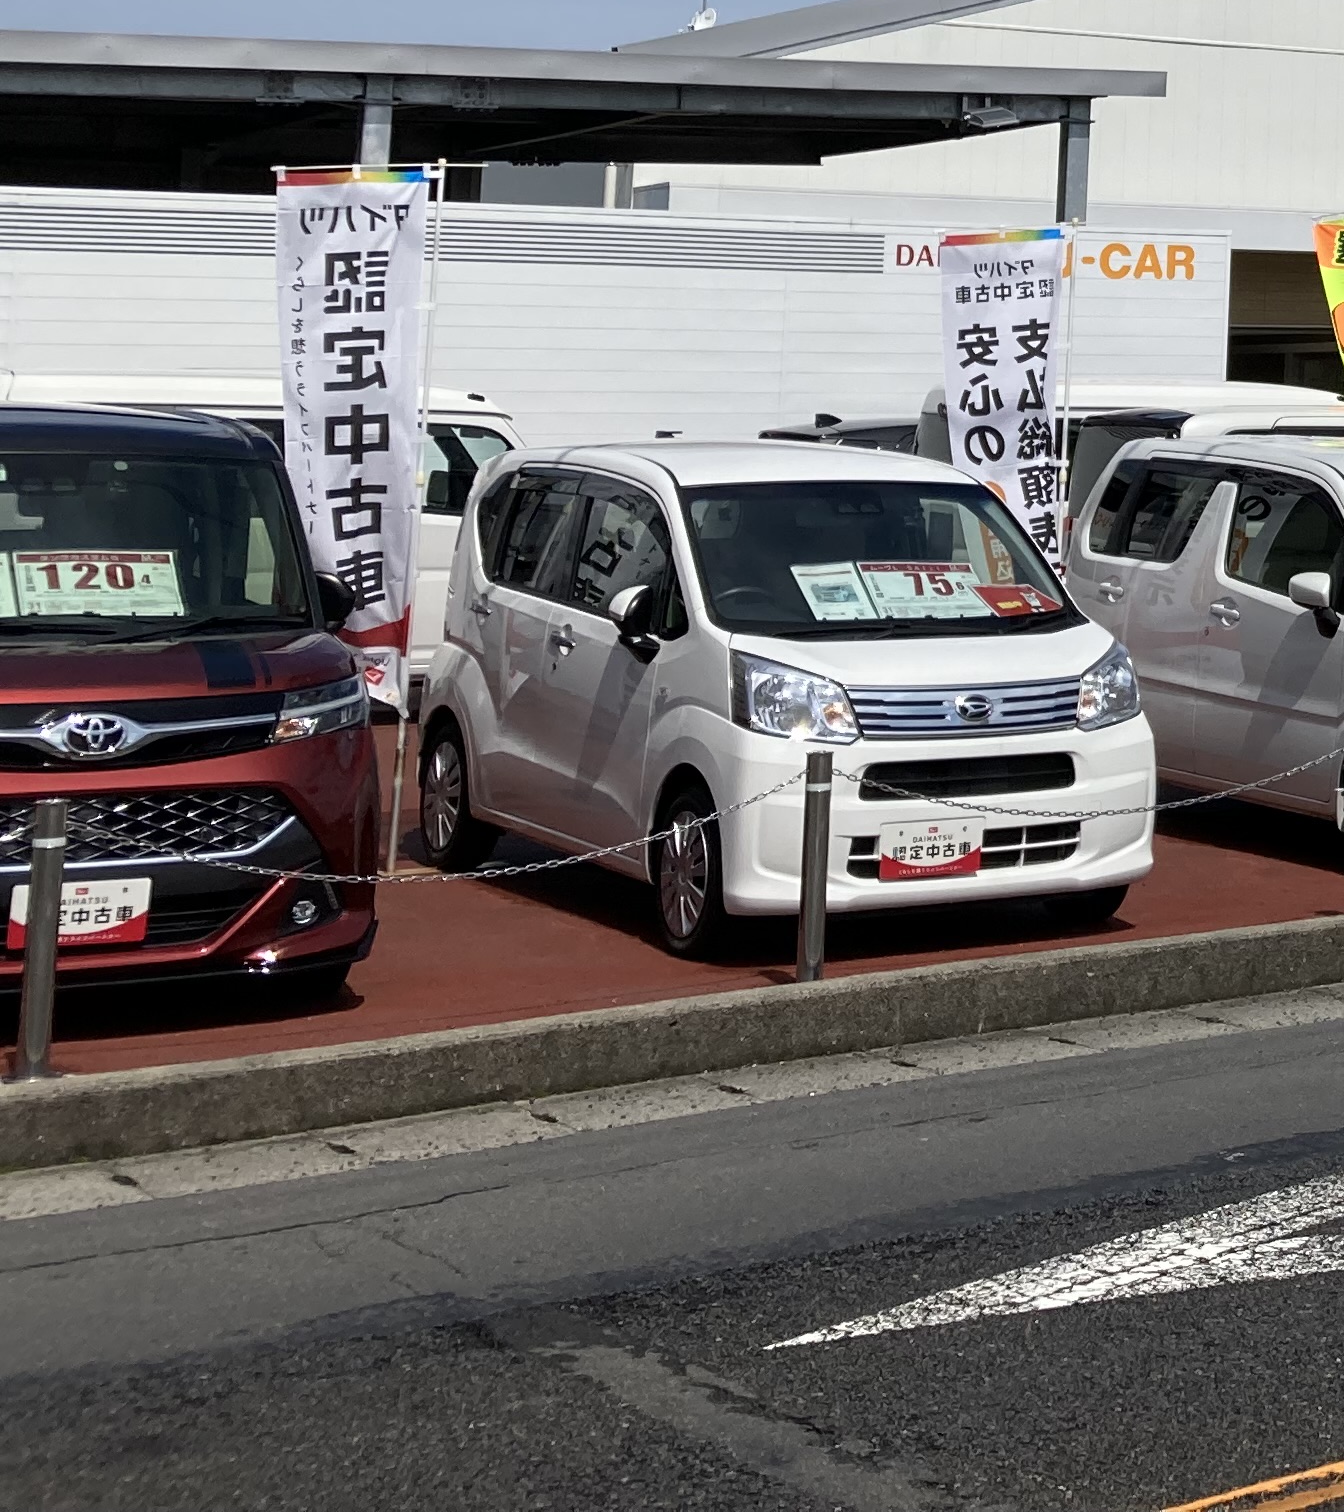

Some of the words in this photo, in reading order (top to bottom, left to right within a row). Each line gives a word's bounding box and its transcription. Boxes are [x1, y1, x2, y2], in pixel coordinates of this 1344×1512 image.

[912, 834, 954, 844] DAIHATSU
[892, 841, 972, 861] 認定中古車
[61, 896, 110, 906] AIHATSU
